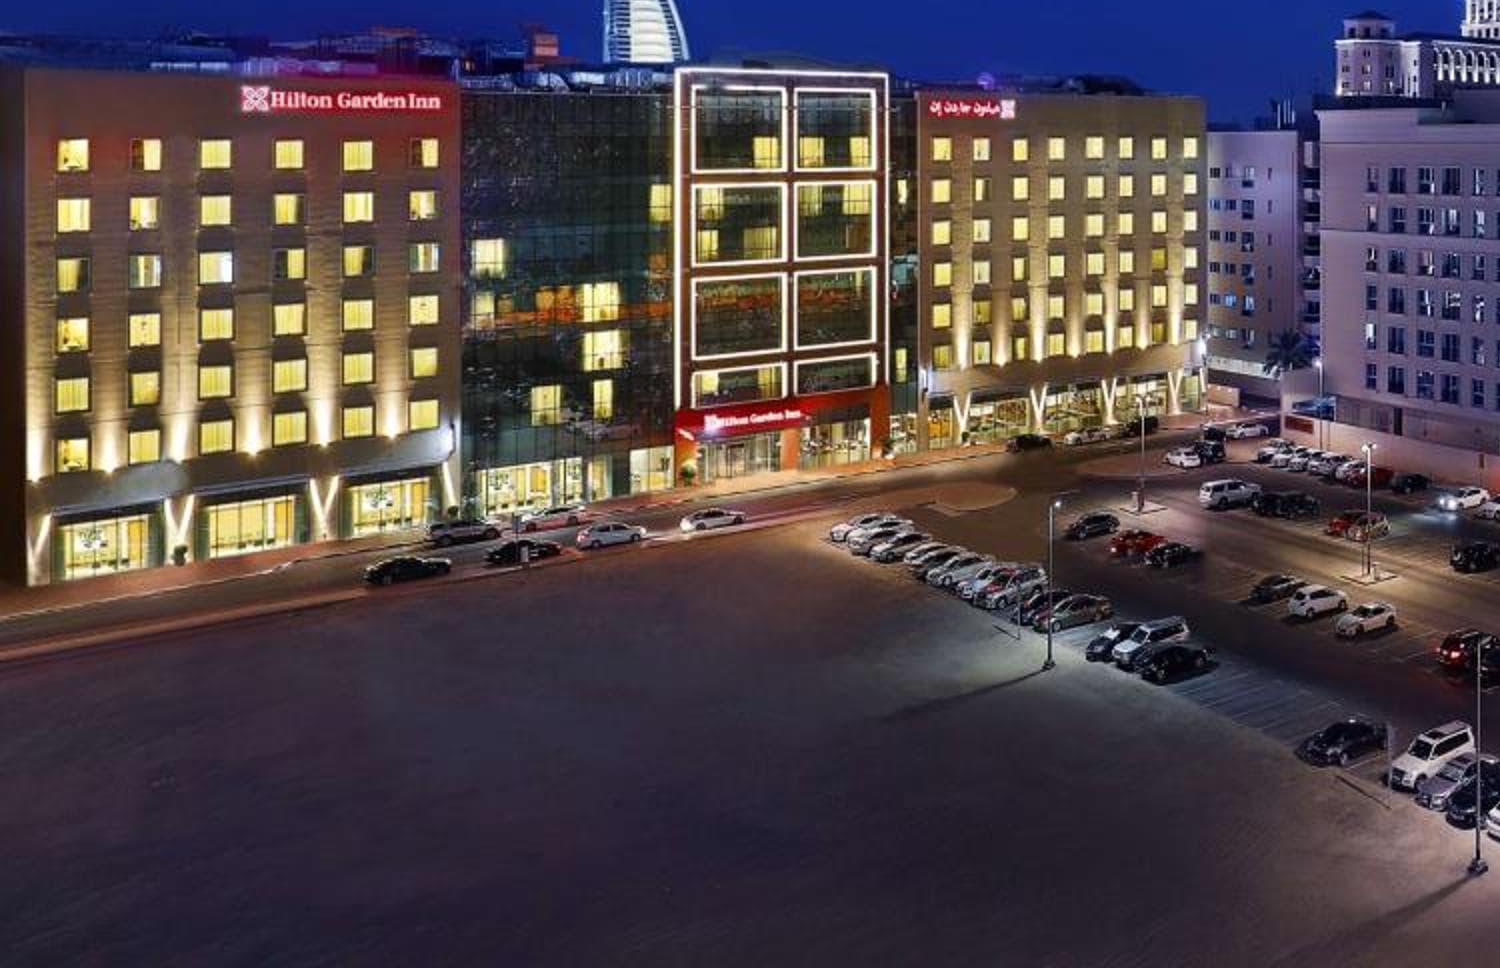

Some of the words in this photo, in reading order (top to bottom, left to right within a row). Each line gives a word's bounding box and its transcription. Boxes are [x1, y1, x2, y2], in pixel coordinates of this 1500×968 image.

[271, 91, 333, 109] Hilton
[337, 92, 408, 109] Garden
[408, 93, 441, 109] Inn
